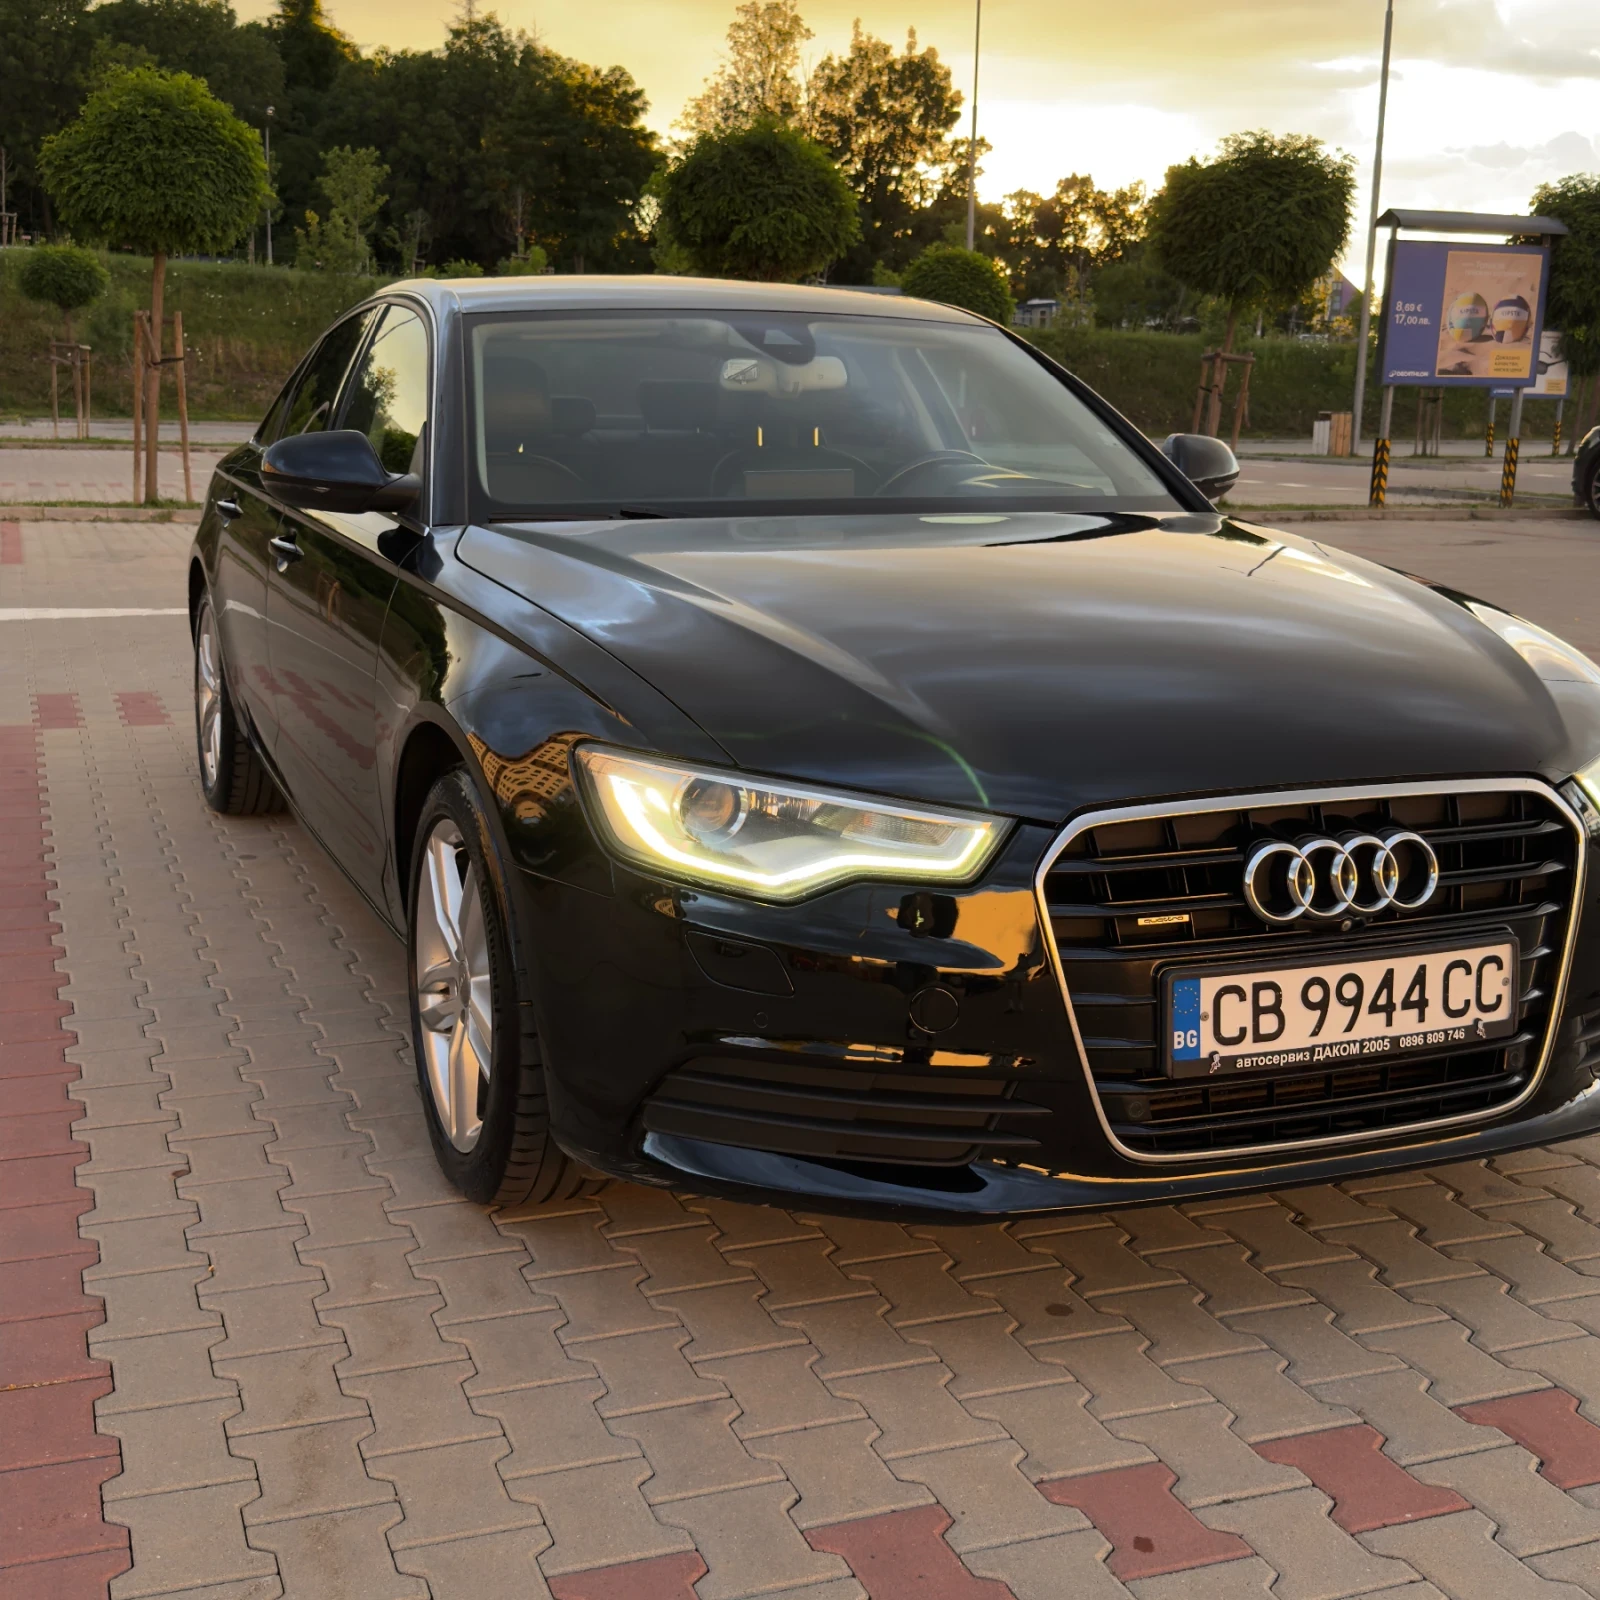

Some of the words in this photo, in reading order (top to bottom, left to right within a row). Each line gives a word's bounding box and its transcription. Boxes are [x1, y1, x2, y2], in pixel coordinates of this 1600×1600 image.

[1396, 300, 1415, 313] 8,69
[1417, 303, 1423, 312] €
[1394, 313, 1418, 326] 17,00
[1418, 317, 1431, 325] лв.
[1143, 916, 1184, 924] quattro
[1212, 981, 1286, 1046] CB
[1300, 963, 1429, 1037] 9944
[1442, 955, 1504, 1018] CC
[1173, 1029, 1198, 1050] BG
[1236, 1051, 1310, 1069] автосервиз
[1313, 1040, 1361, 1062] ДАКОМ
[1362, 1037, 1391, 1055] 2005
[1400, 1033, 1425, 1048] 0896
[1426, 1031, 1445, 1046] 809
[1447, 1027, 1466, 1043] 746
